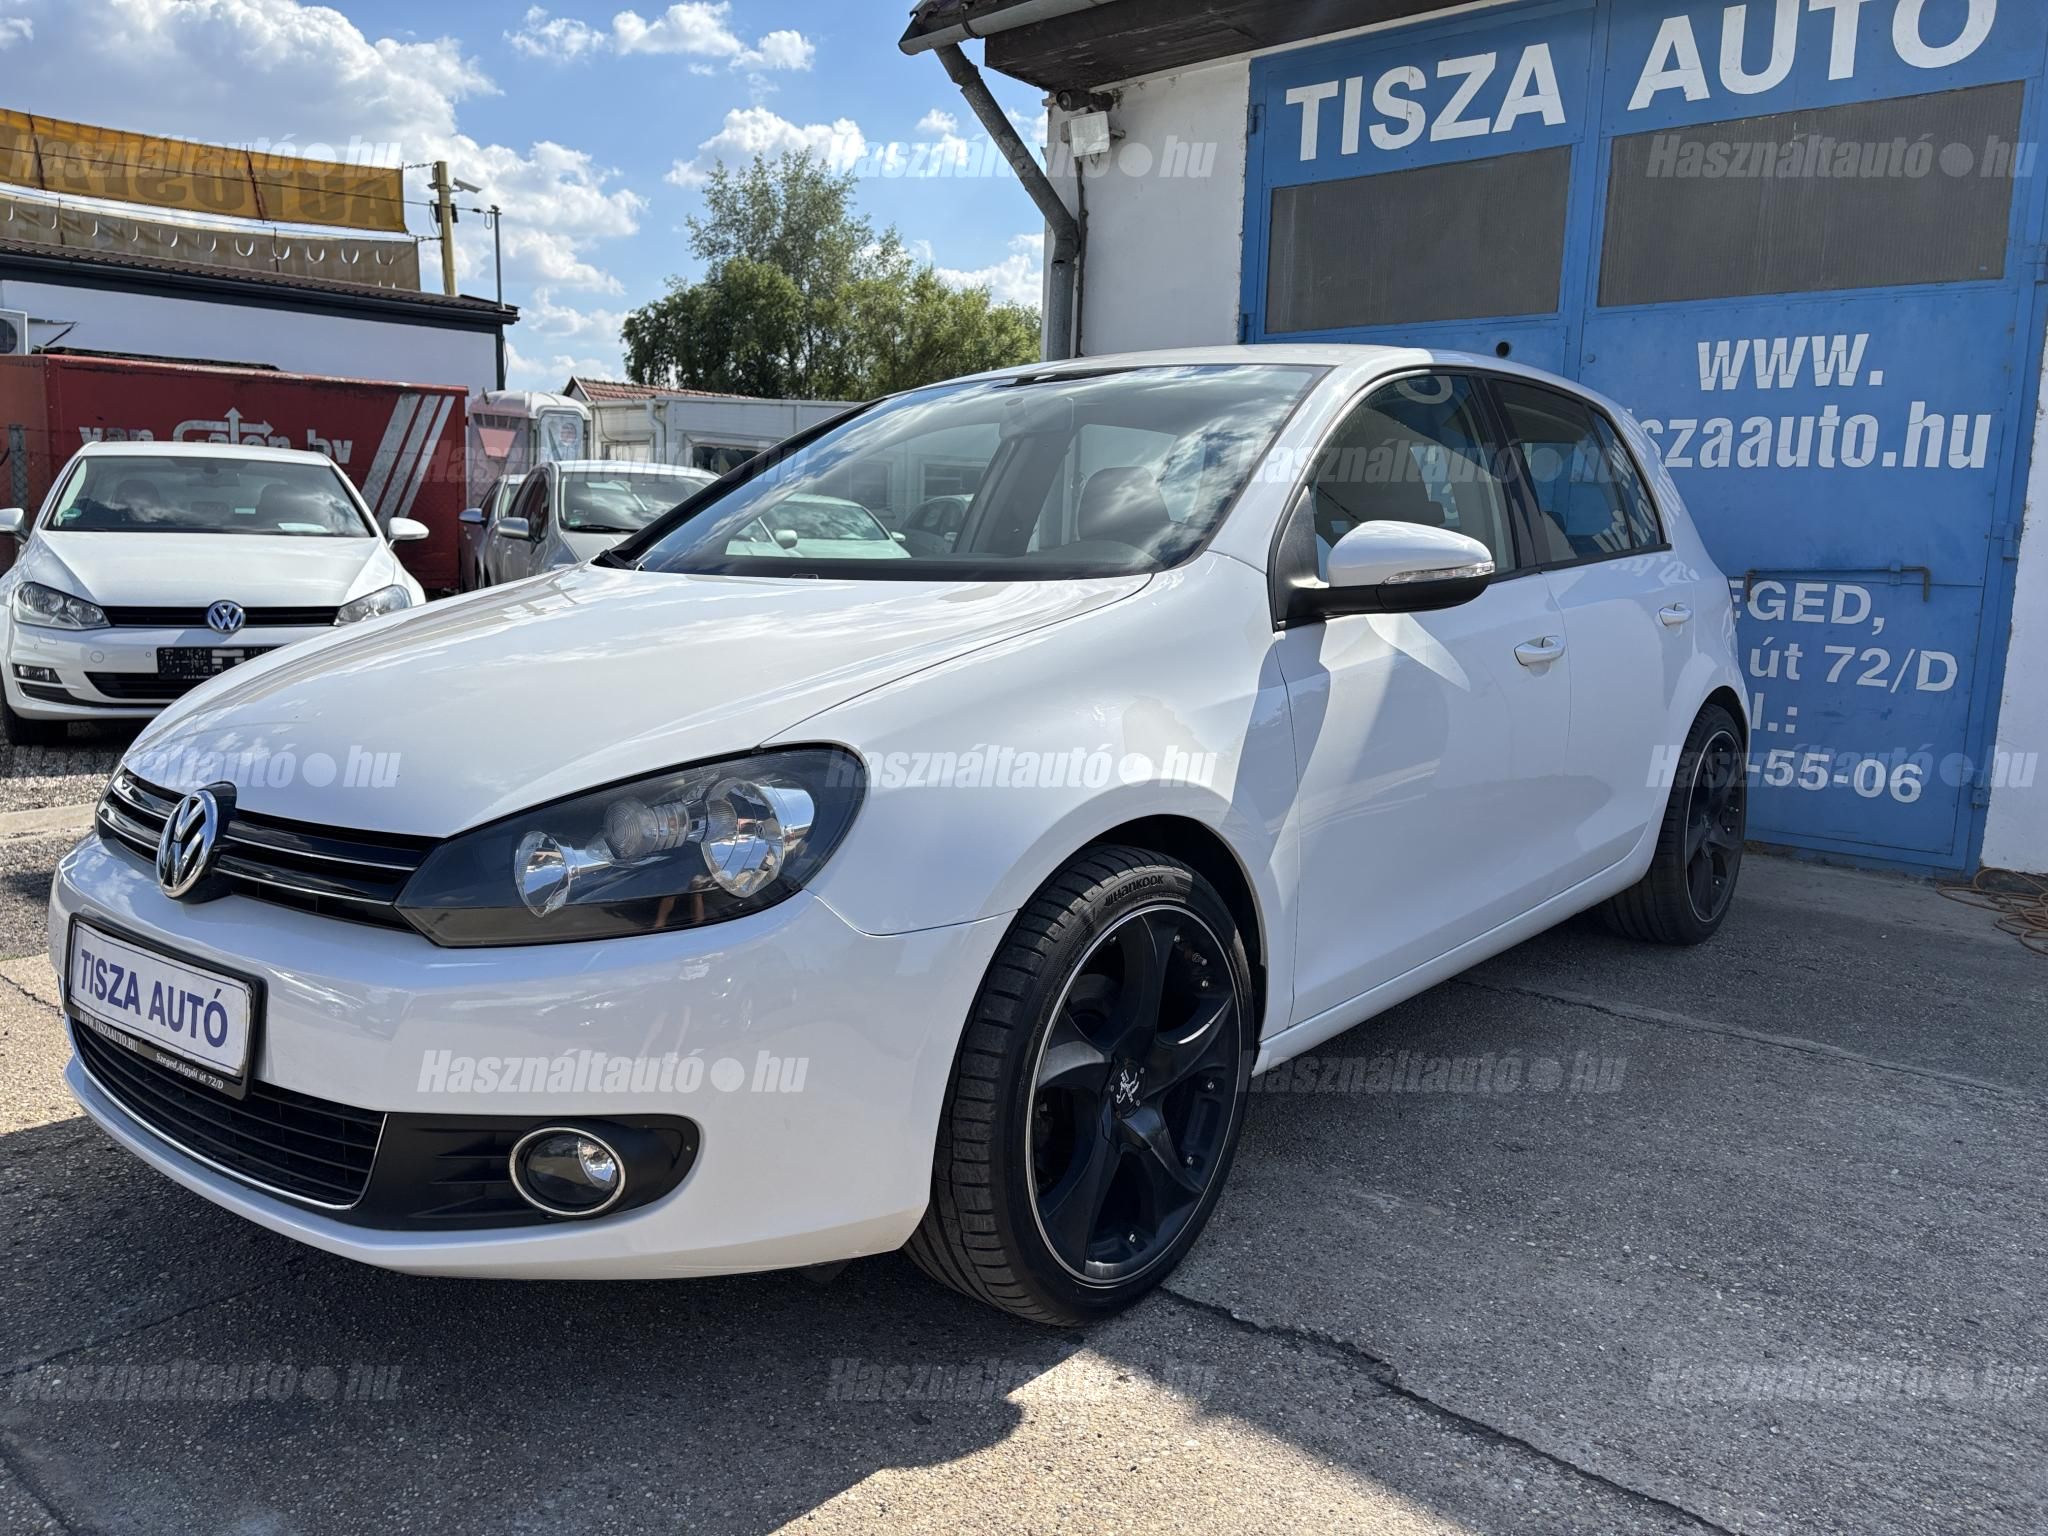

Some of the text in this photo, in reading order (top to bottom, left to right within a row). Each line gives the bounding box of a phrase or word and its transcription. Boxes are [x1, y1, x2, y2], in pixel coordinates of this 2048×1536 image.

[1286, 42, 1566, 161] TISZA
[1697, 333, 1883, 391] www.
[1627, 401, 1991, 468] szaauto.hu
[1750, 637, 1958, 694] út 72/D
[81, 949, 228, 1048] TISZA AUTÓ
